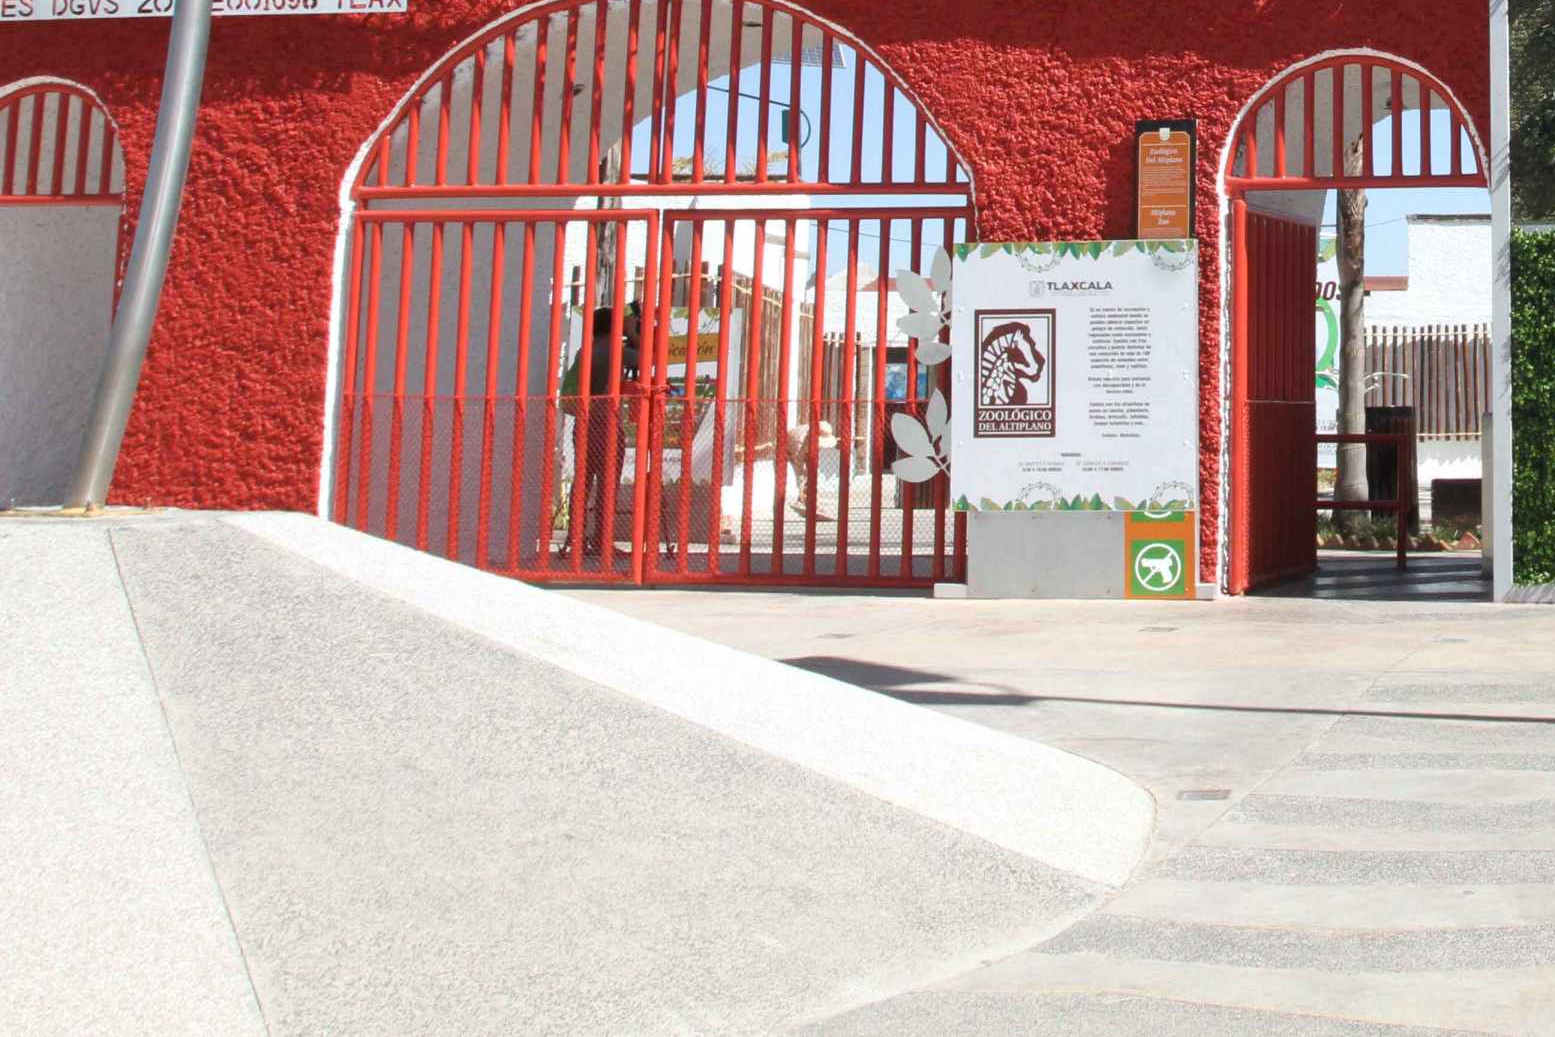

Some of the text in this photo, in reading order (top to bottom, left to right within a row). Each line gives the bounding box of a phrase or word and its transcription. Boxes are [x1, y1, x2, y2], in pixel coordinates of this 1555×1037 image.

[1047, 281, 1112, 291] TLAXCALA
[978, 408, 1052, 421] ZOOLÓGICO
[979, 422, 1052, 431] DEL ALTIPLANO
